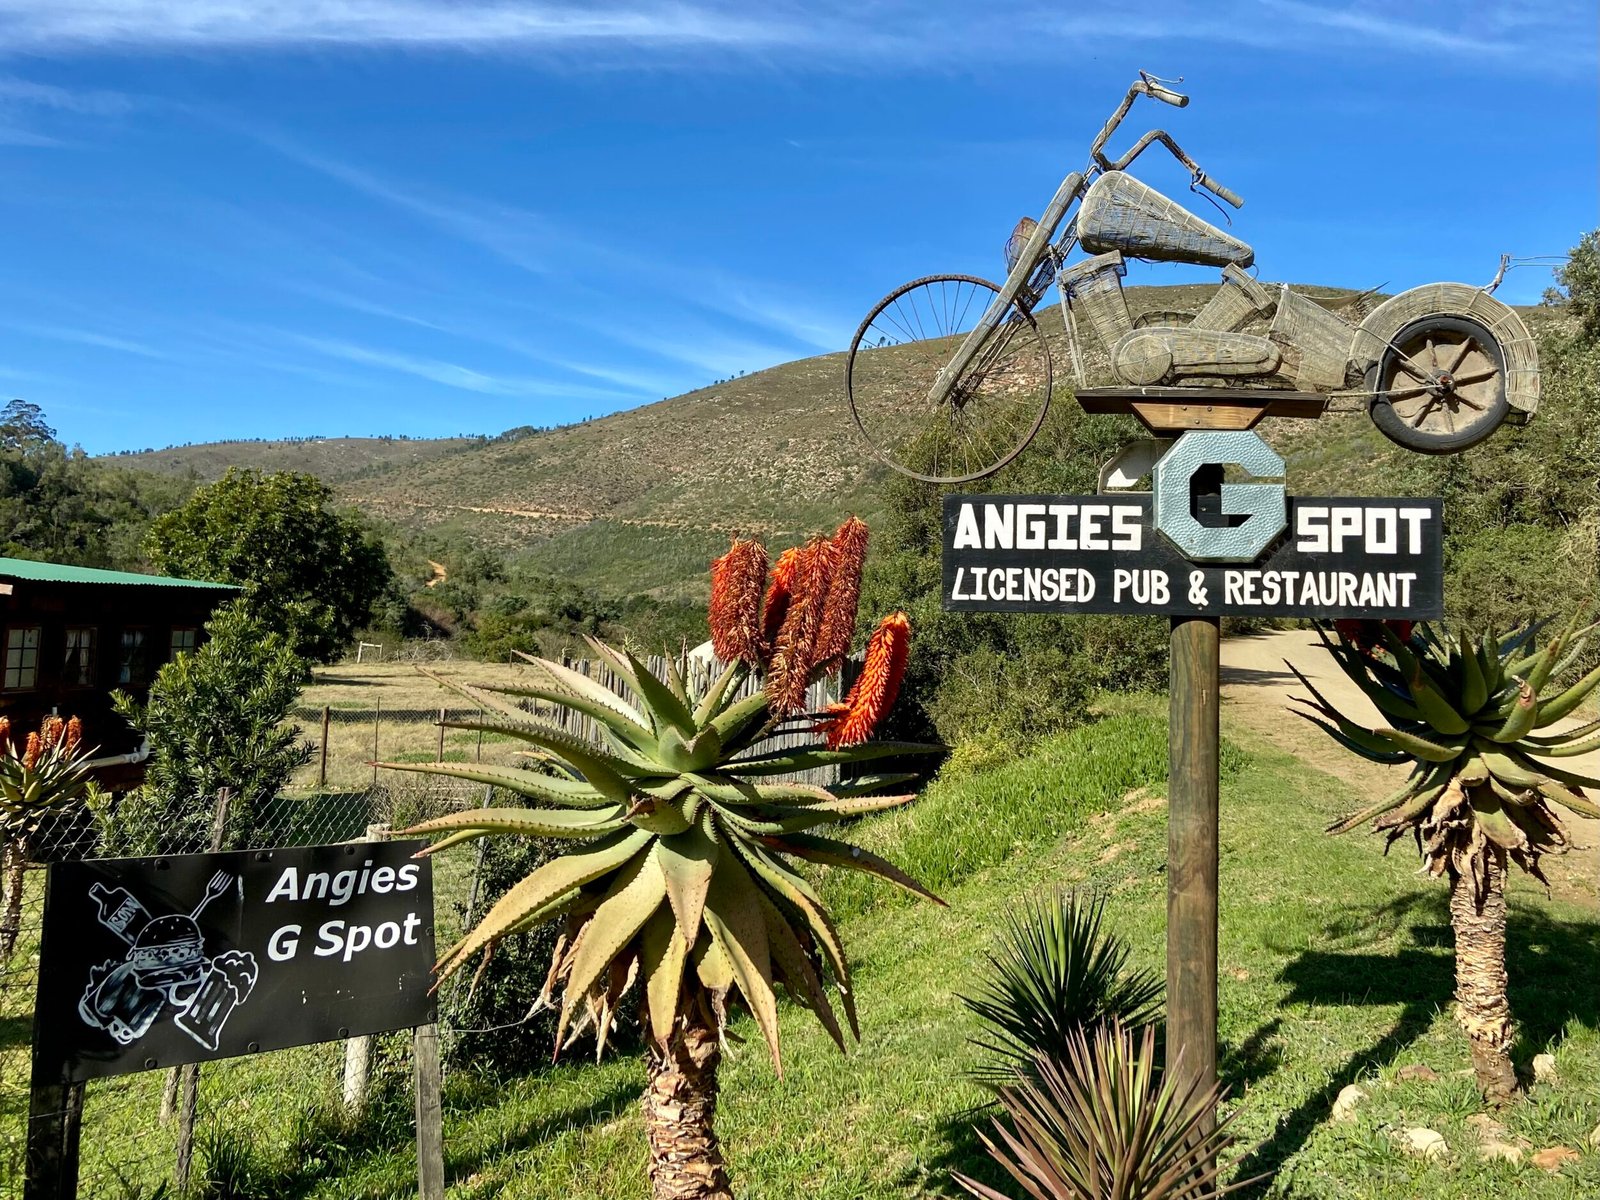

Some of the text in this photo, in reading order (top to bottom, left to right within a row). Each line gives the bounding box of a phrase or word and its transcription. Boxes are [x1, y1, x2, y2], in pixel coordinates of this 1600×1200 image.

[953, 430, 1432, 562] ANGIES G SPOT
[951, 567, 1417, 608] LICENSED PUB & RESTAURANT
[265, 860, 420, 906] Angies
[267, 913, 422, 962] G Spot
